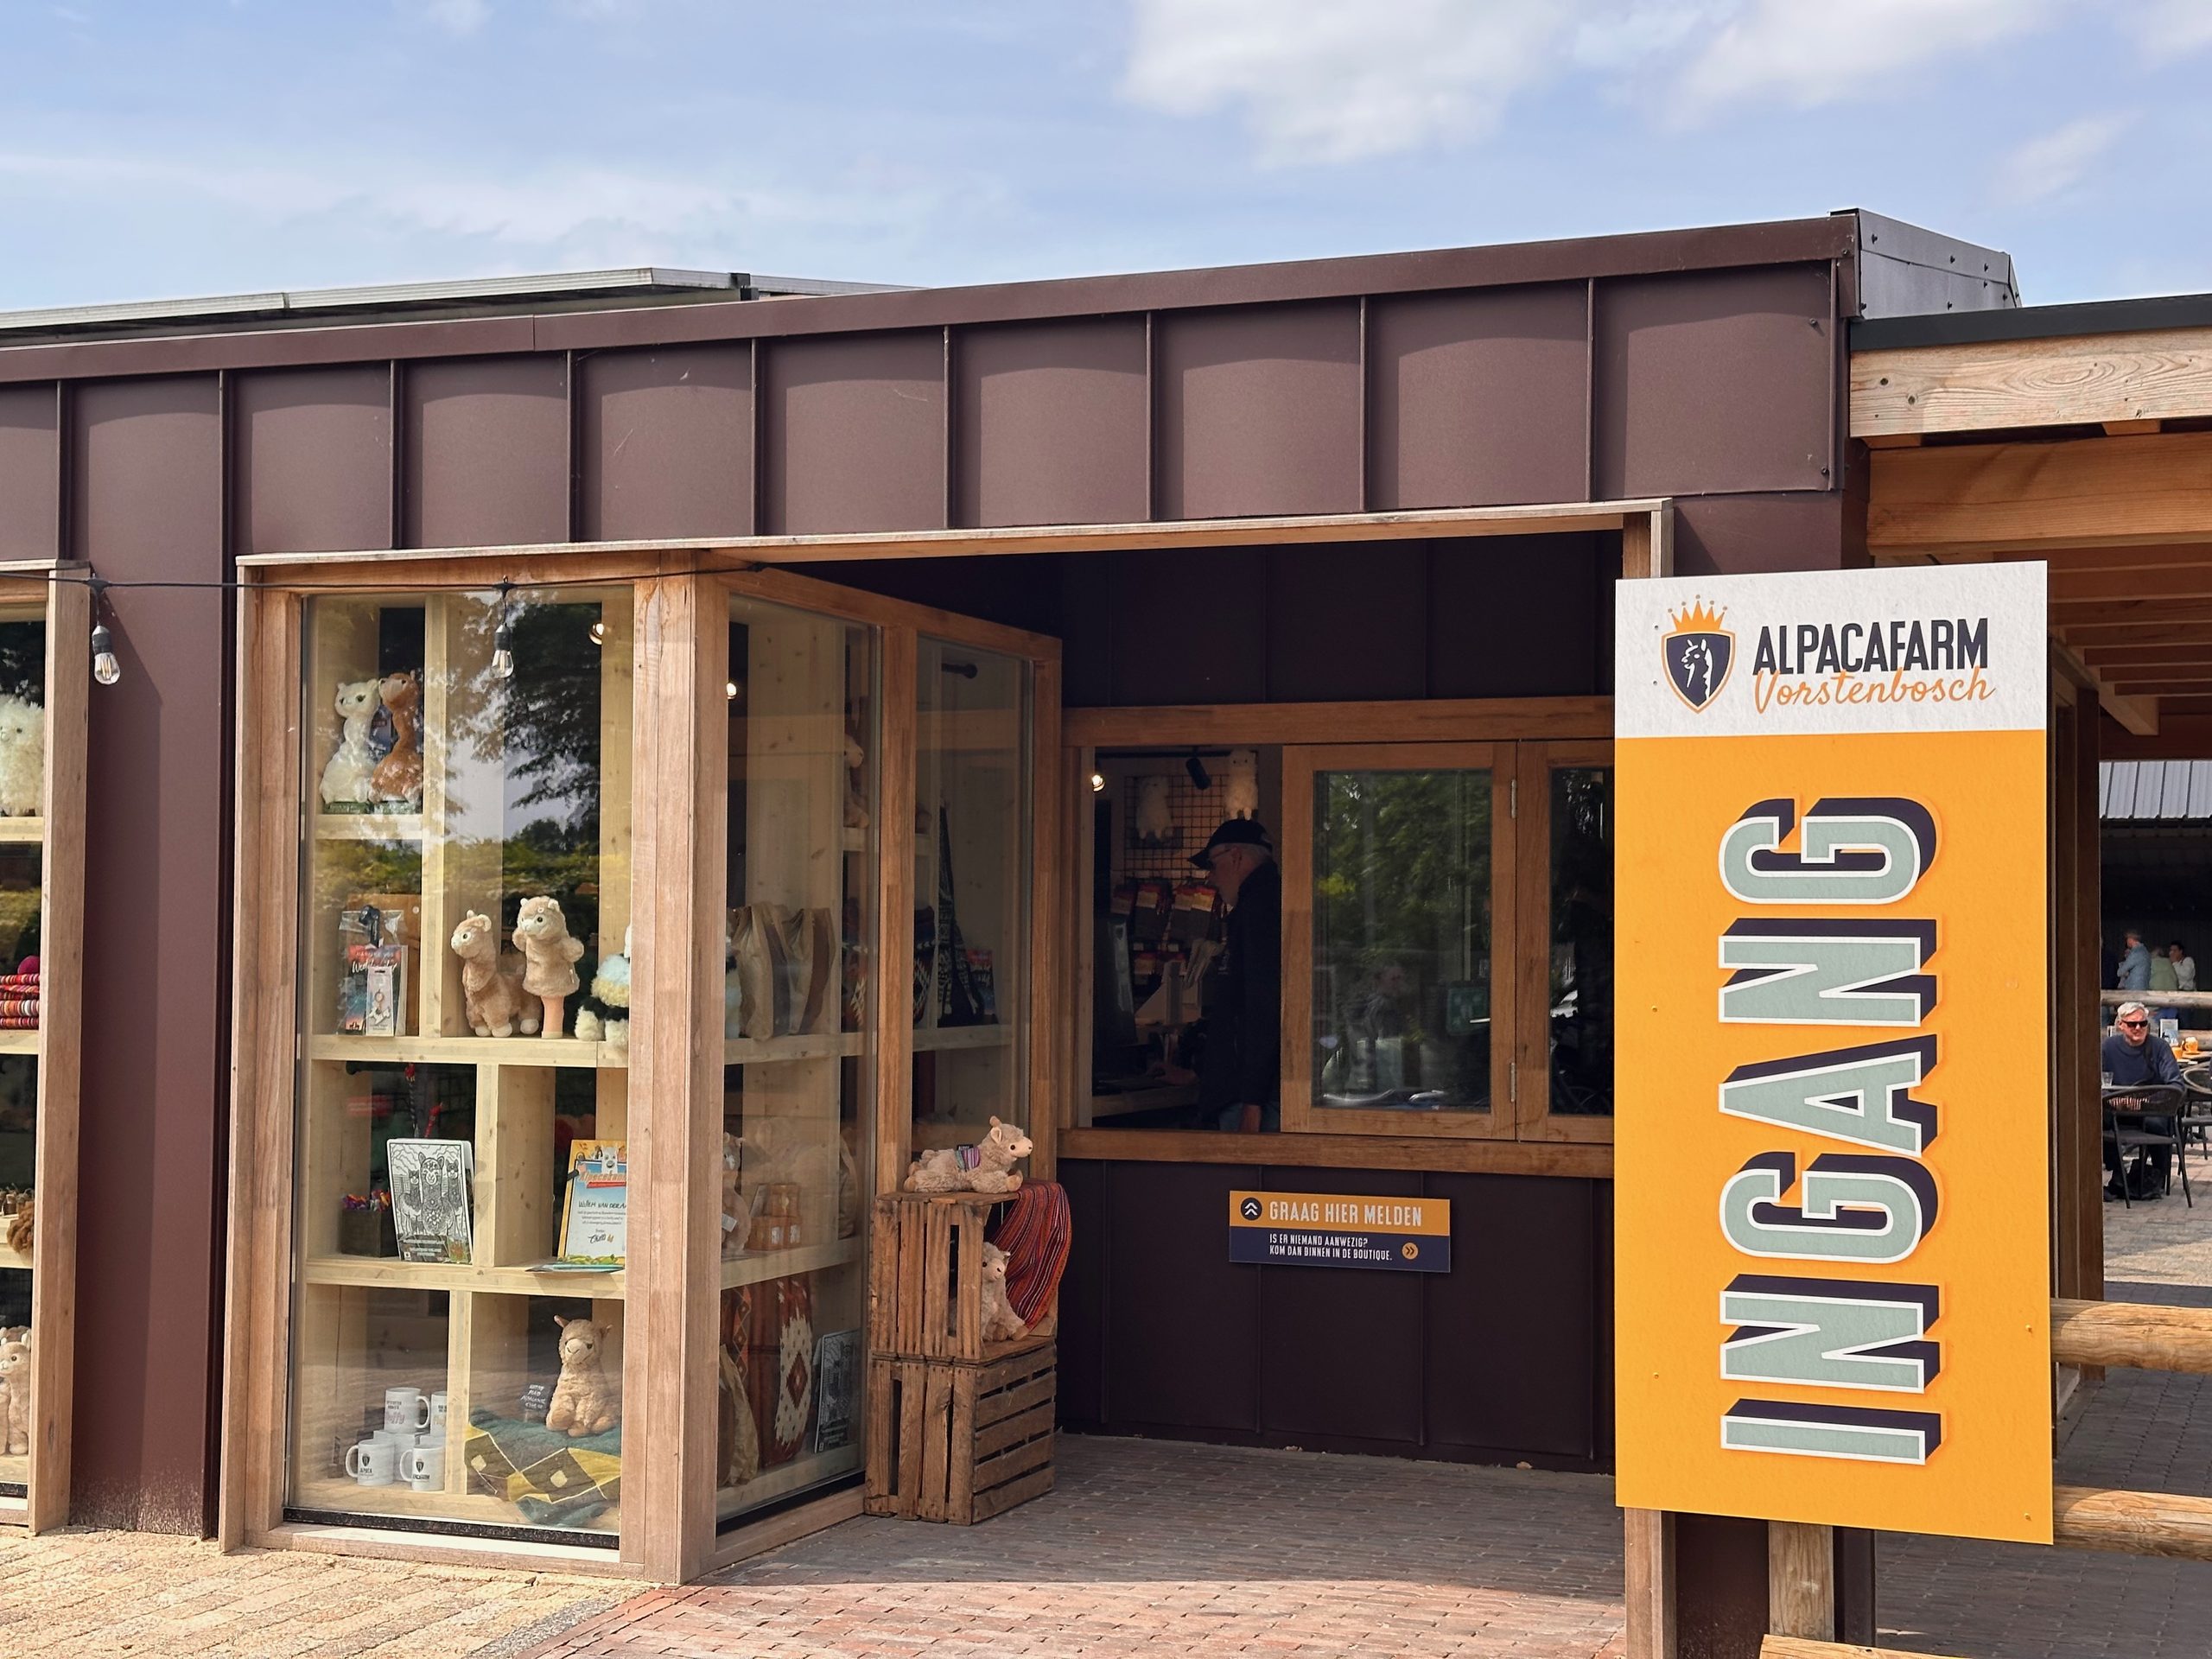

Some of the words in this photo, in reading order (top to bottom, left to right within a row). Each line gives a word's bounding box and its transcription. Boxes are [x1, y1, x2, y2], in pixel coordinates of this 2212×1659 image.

[1752, 617, 1988, 676] ALPACAFARM
[1752, 666, 1997, 715] Vorstenbosch
[1719, 798, 1939, 1466] INGANG
[1269, 1201, 1319, 1223] GRAAG
[1325, 1203, 1358, 1224] HIER
[1363, 1205, 1422, 1227] MELDEN
[1269, 1233, 1277, 1243] IS
[1279, 1234, 1288, 1244] ER
[1290, 1234, 1323, 1246] NIEMAND
[1325, 1236, 1369, 1249] AANWEZIG?
[1269, 1245, 1285, 1255] KOM
[1287, 1245, 1302, 1256] DAN
[1304, 1246, 1331, 1258] BINNEN
[1332, 1248, 1340, 1258] IN
[1342, 1248, 1351, 1259] DE
[1353, 1249, 1393, 1262] BOUTIQUE.
